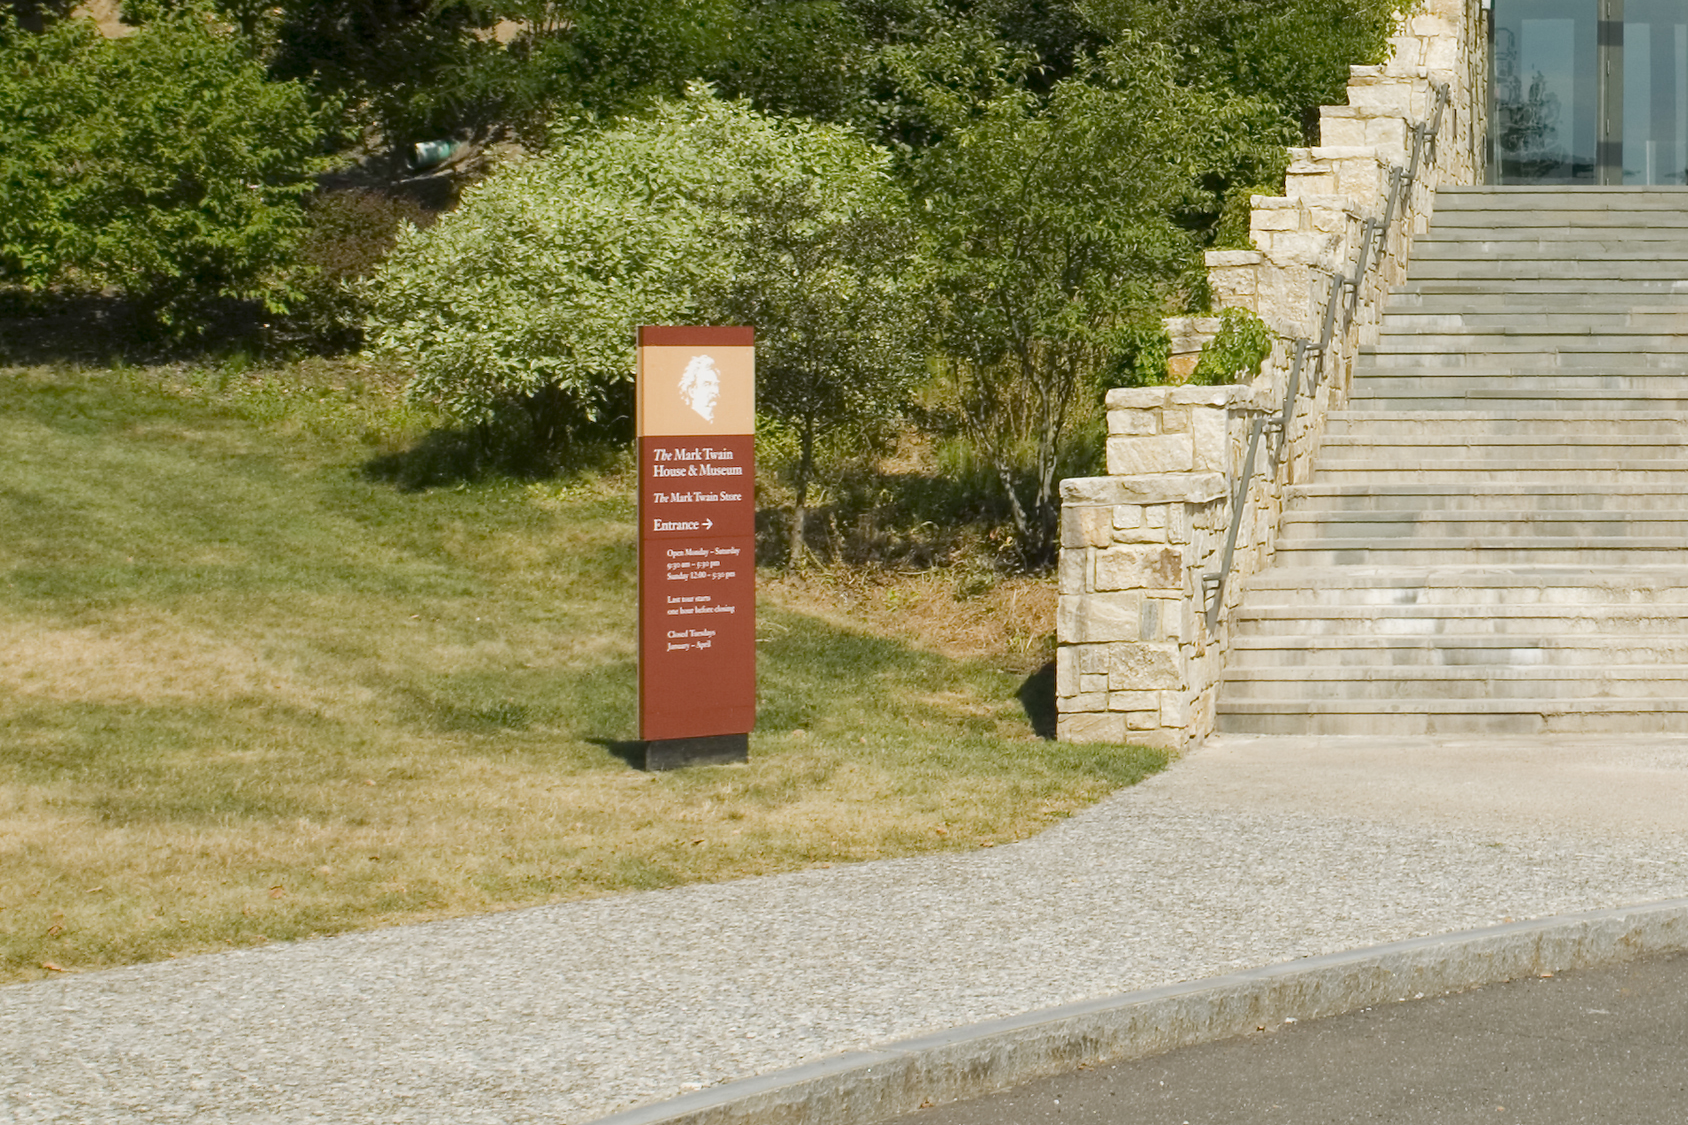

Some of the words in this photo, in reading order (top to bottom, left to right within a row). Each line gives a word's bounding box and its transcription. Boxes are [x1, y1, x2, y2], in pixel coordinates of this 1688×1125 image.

[654, 449, 672, 461] The
[674, 448, 702, 460] Mark
[703, 448, 733, 460] Twain
[653, 465, 686, 477] House
[688, 465, 698, 476] &
[700, 464, 742, 476] Museum
[654, 493, 669, 503] The
[670, 493, 692, 502] Mark
[694, 492, 718, 502] Twain
[720, 491, 742, 502] Store
[654, 519, 699, 531] Entrance
[667, 549, 684, 558] Open
[685, 548, 709, 557] Monday
[715, 547, 740, 556] Saturday
[667, 572, 689, 581] Sunday
[714, 605, 735, 613] closing
[667, 630, 688, 638] Closed
[689, 629, 716, 638] Tuesdays
[667, 643, 689, 651] January
[696, 640, 711, 650] April
